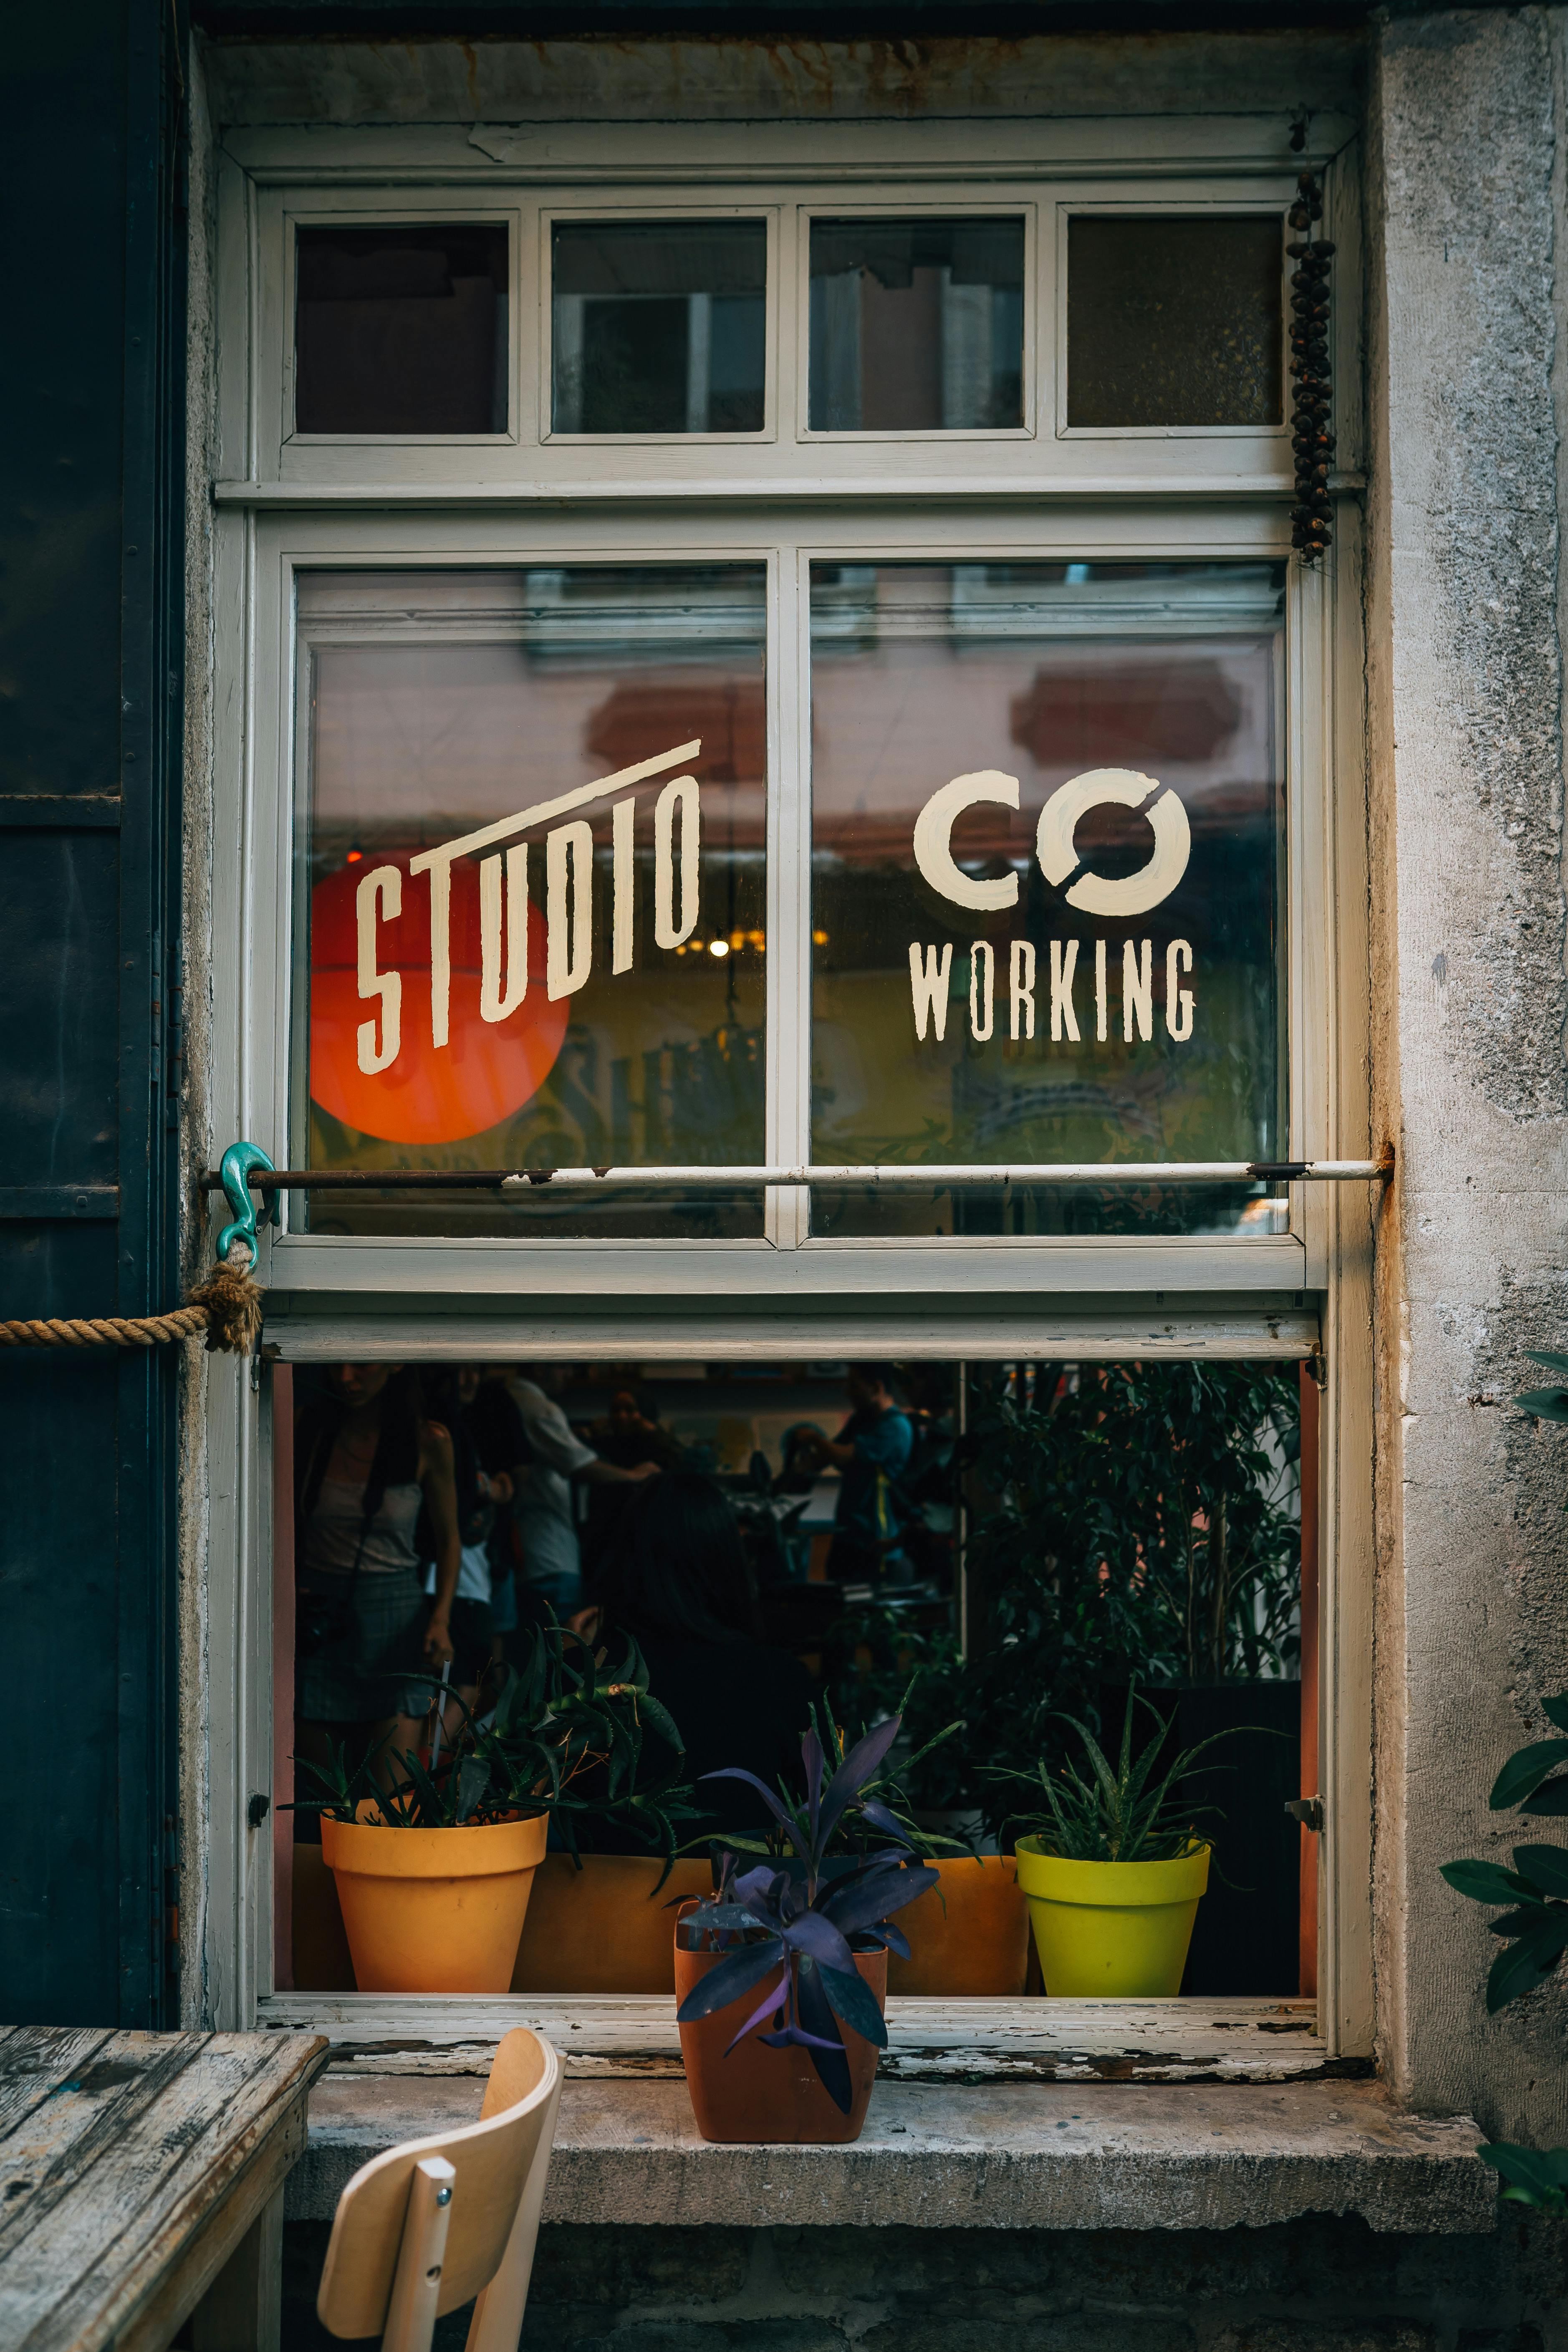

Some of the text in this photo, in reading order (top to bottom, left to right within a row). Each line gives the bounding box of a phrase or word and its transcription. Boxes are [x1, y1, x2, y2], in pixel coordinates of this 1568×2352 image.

[356, 738, 702, 1076] STUDIO
[913, 767, 1191, 917] CO
[908, 938, 1197, 1043] WORKING
